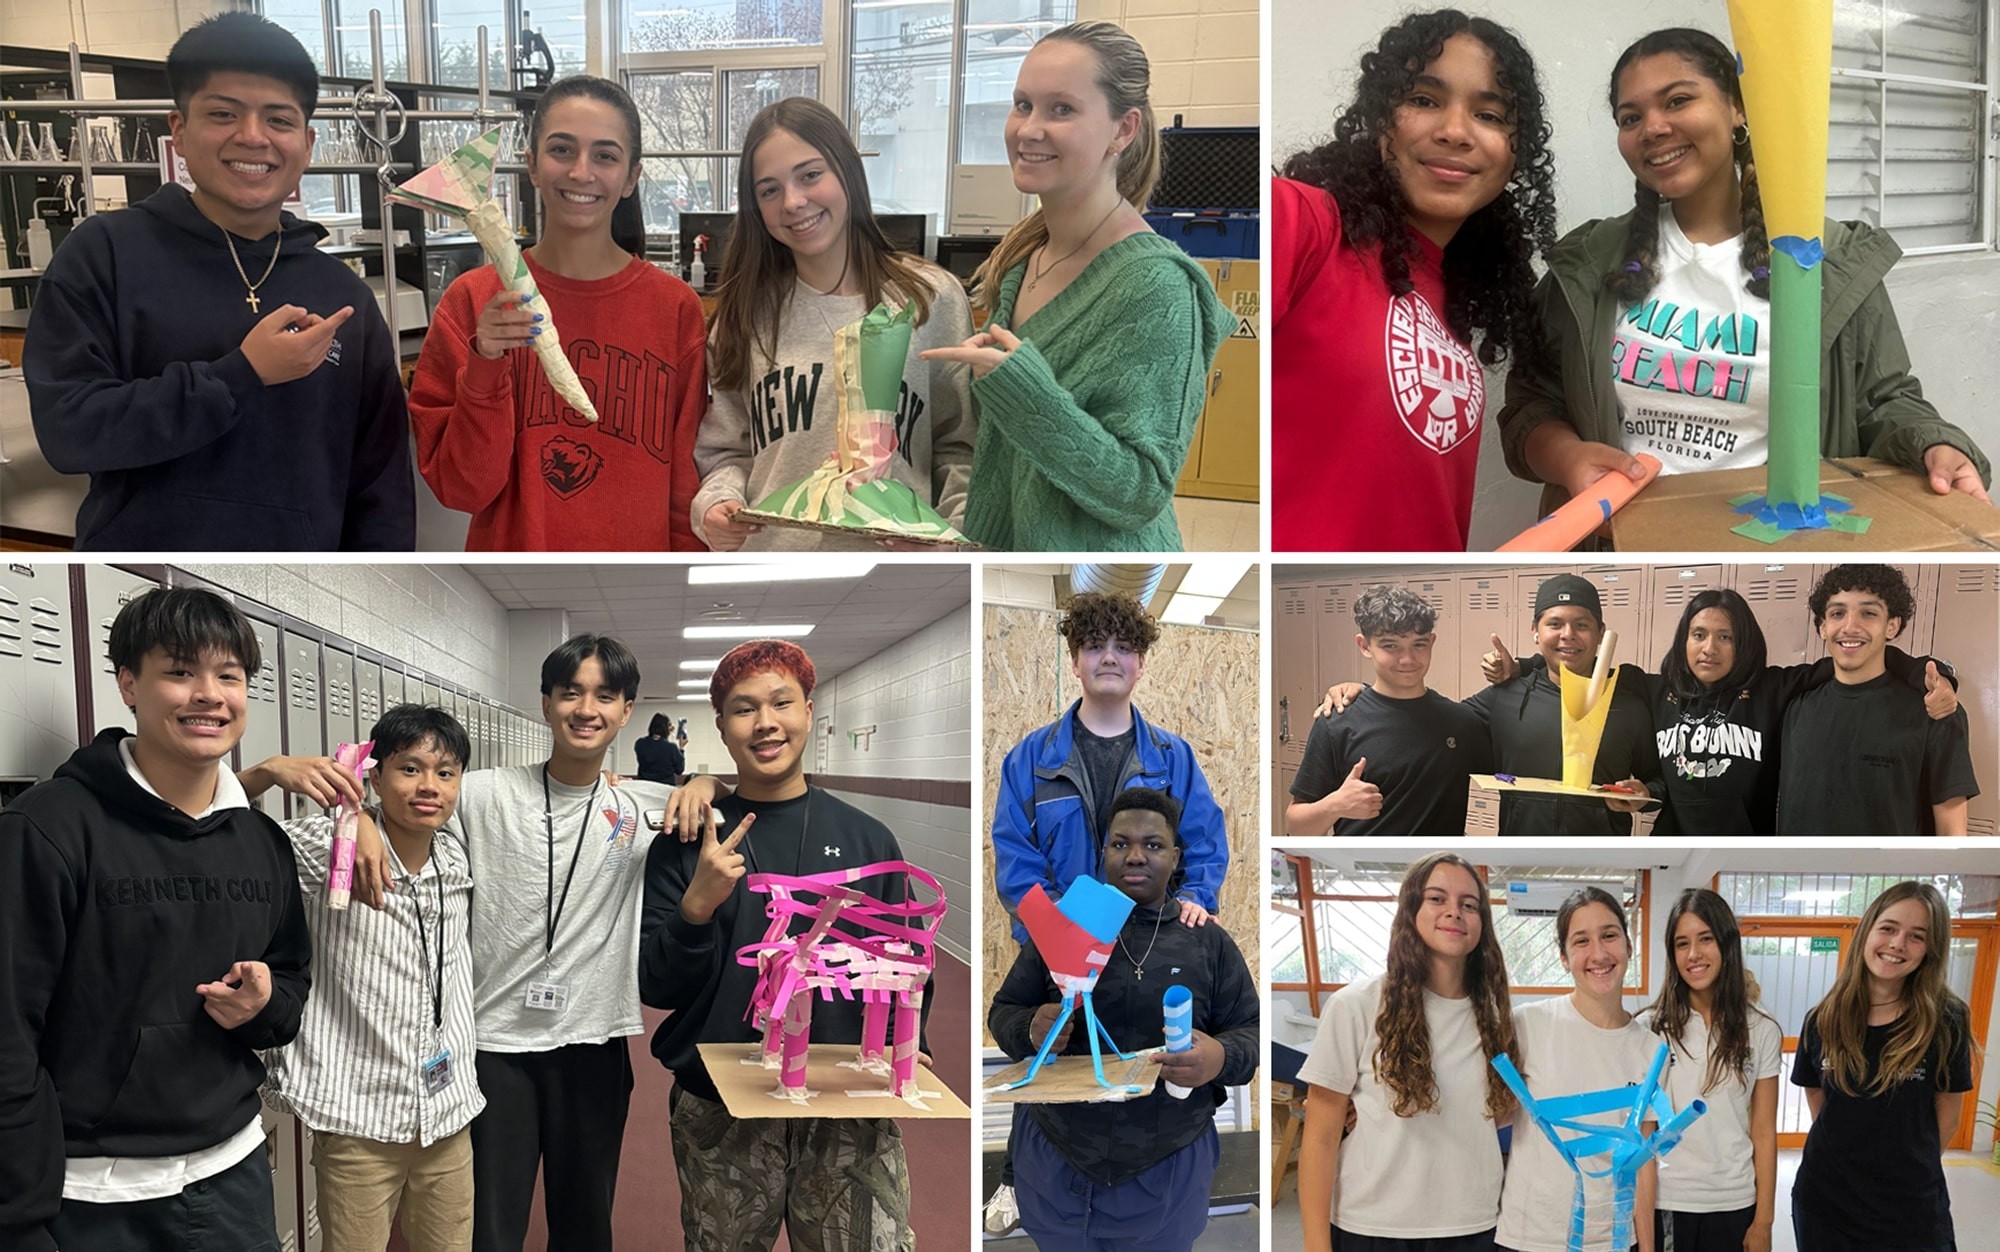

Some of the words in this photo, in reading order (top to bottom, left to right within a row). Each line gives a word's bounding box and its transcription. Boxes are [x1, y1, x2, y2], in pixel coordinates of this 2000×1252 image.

[1616, 297, 1758, 356] MIAMI
[1612, 335, 1750, 404] BEACH
[751, 363, 824, 457] NEW
[1637, 408, 1659, 417] LOVE
[1662, 411, 1685, 420] YOUR
[1625, 419, 1678, 440] SOUTH
[1682, 422, 1738, 453] BEACH
[1647, 439, 1713, 461] FLORIDA
[1690, 722, 1763, 762] BUNNY
[97, 875, 221, 906] KENNETH
[1813, 939, 1838, 948] SALIDA
